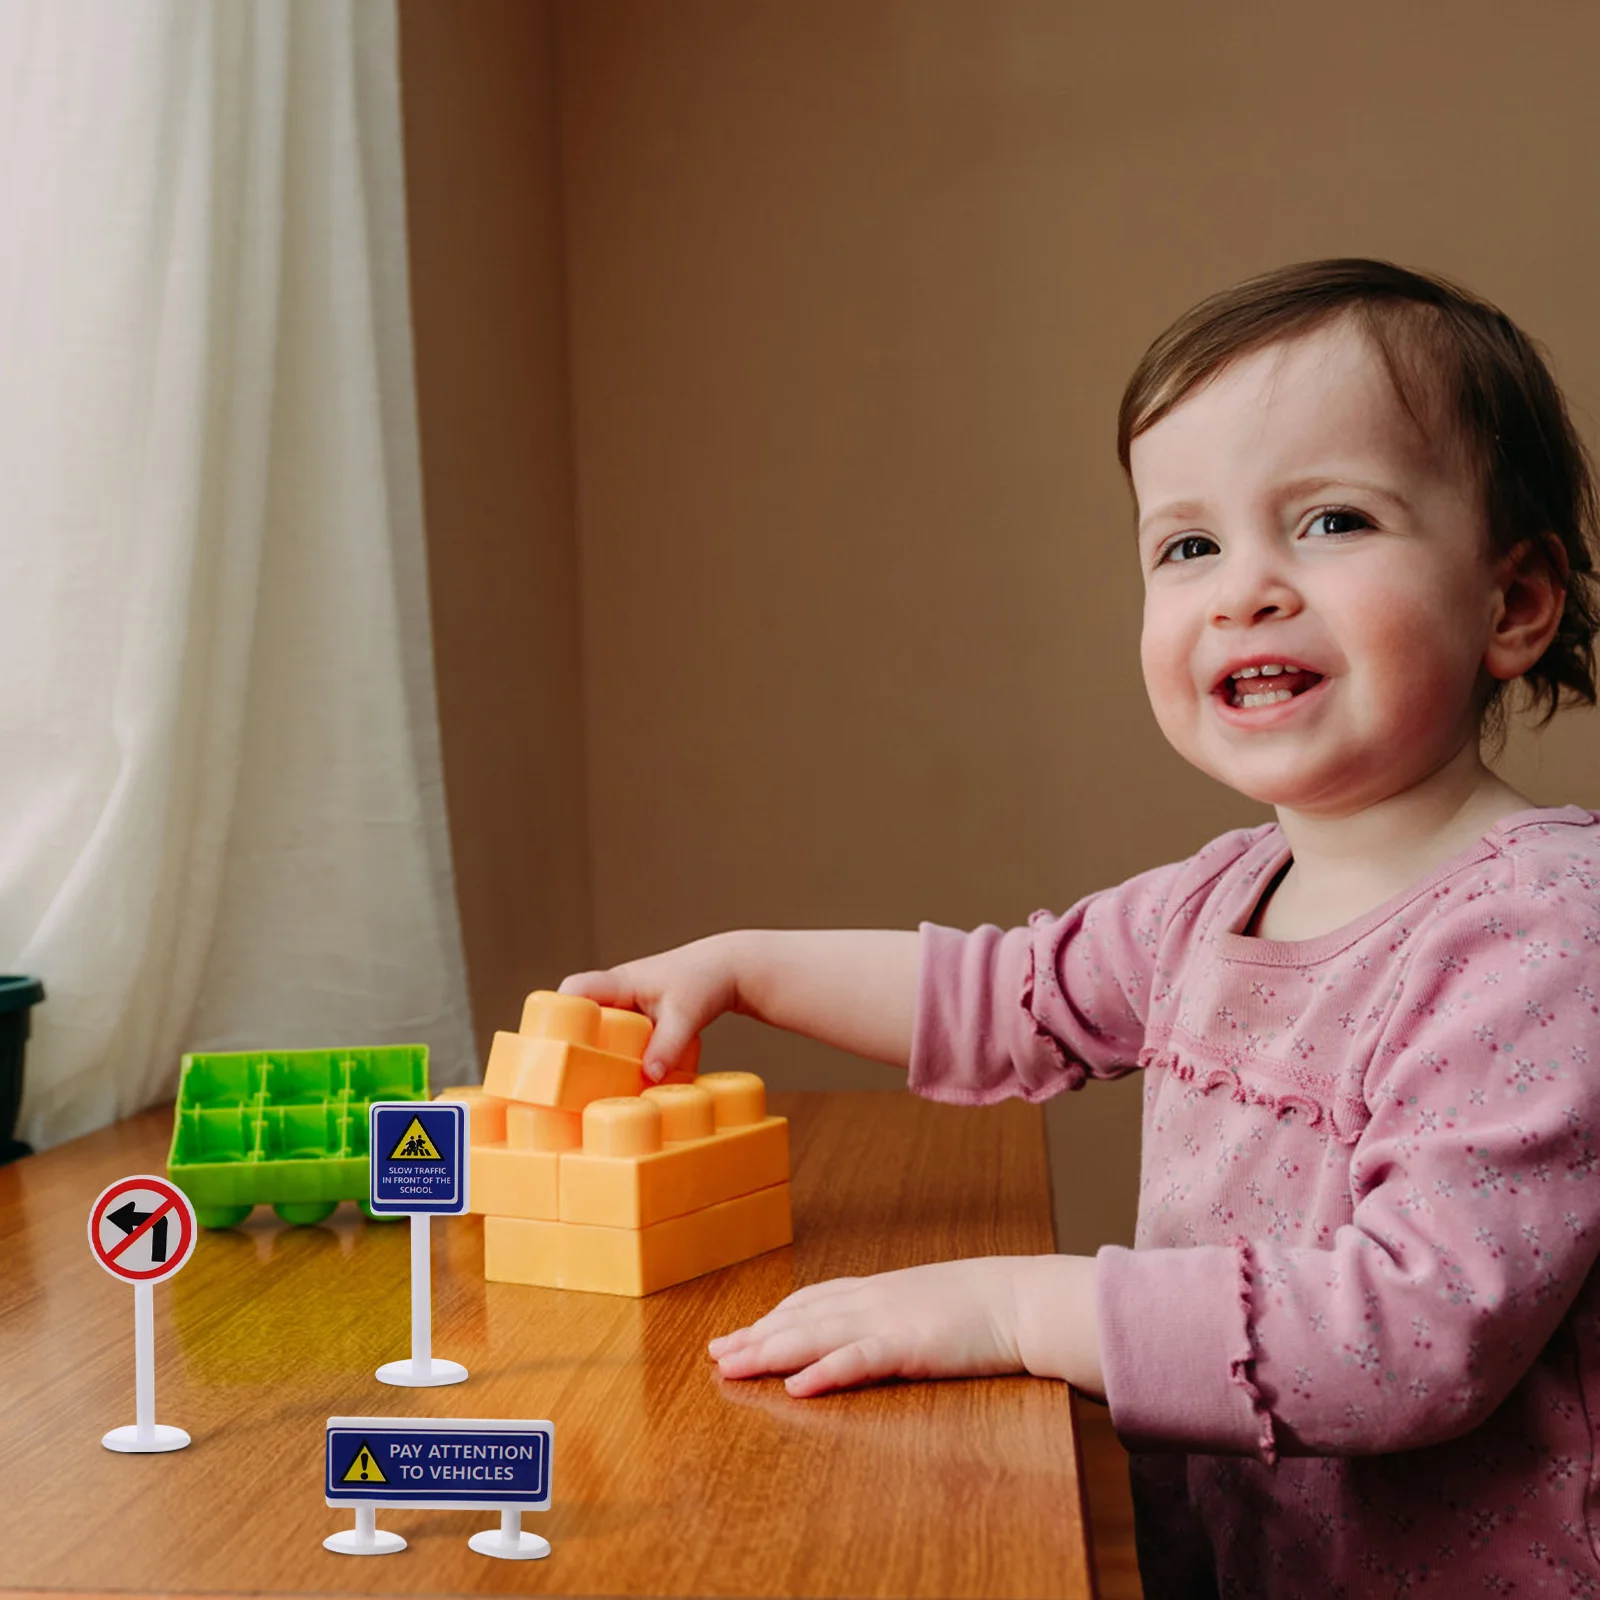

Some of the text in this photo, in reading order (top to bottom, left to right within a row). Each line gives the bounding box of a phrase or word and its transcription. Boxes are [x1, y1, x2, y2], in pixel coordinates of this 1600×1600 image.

[388, 1166, 447, 1175] SLOW TRAFFIC
[382, 1176, 451, 1185] IN FRONT OF THE
[399, 1186, 433, 1194] SCHOOL
[389, 1443, 533, 1460] PAY ATTENTION
[399, 1465, 514, 1481] TO VEHICLES
